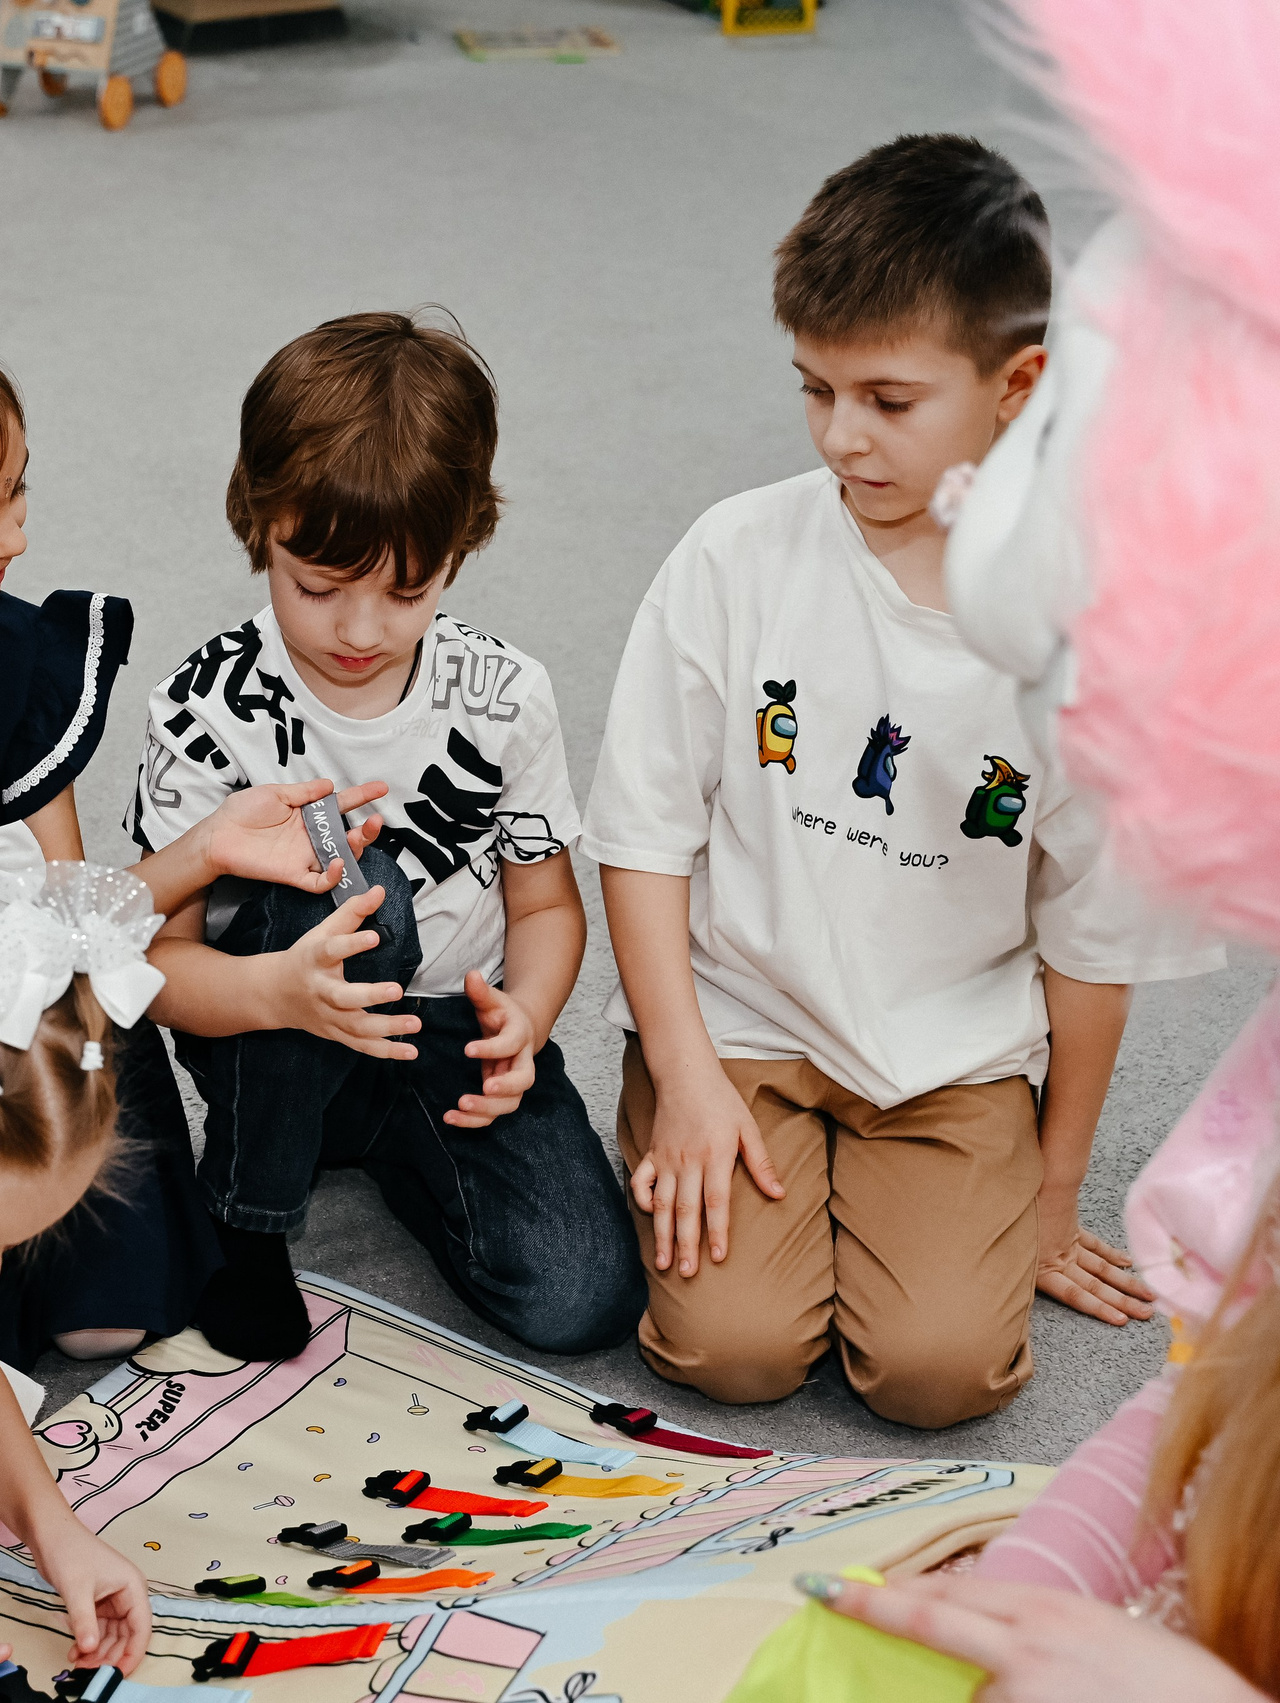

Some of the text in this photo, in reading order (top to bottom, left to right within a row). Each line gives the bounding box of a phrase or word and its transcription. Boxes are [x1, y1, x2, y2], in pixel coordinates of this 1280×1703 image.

[431, 633, 523, 723] FUL
[313, 811, 353, 889] MONSTS
[792, 806, 950, 870] where were you?
[135, 1380, 186, 1442] SUPER!
